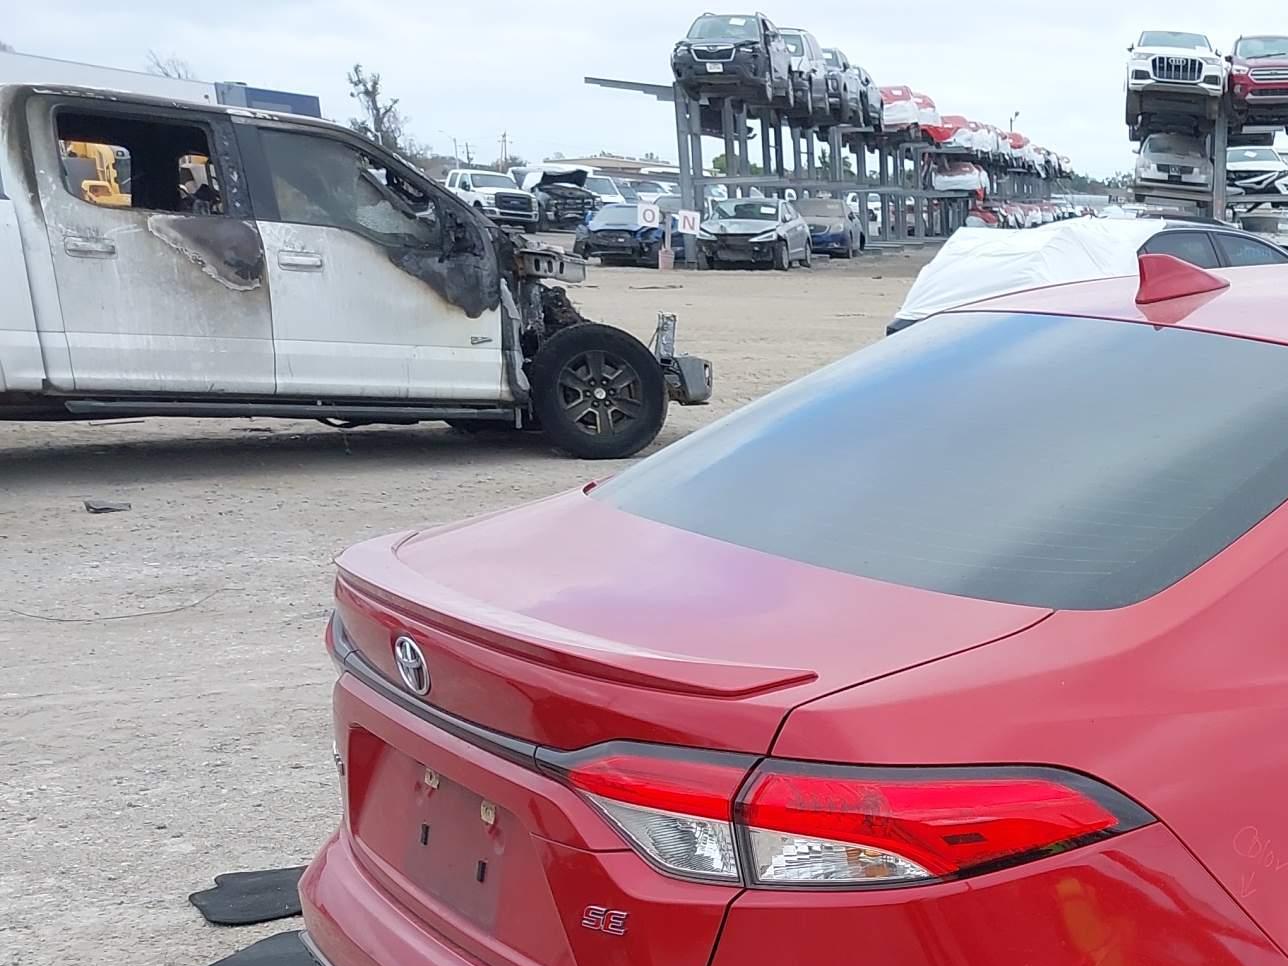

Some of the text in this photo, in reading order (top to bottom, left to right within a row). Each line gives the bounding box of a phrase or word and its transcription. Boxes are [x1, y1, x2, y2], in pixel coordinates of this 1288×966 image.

[642, 208, 656, 224] O
[683, 215, 696, 231] N
[582, 905, 628, 936] SE
